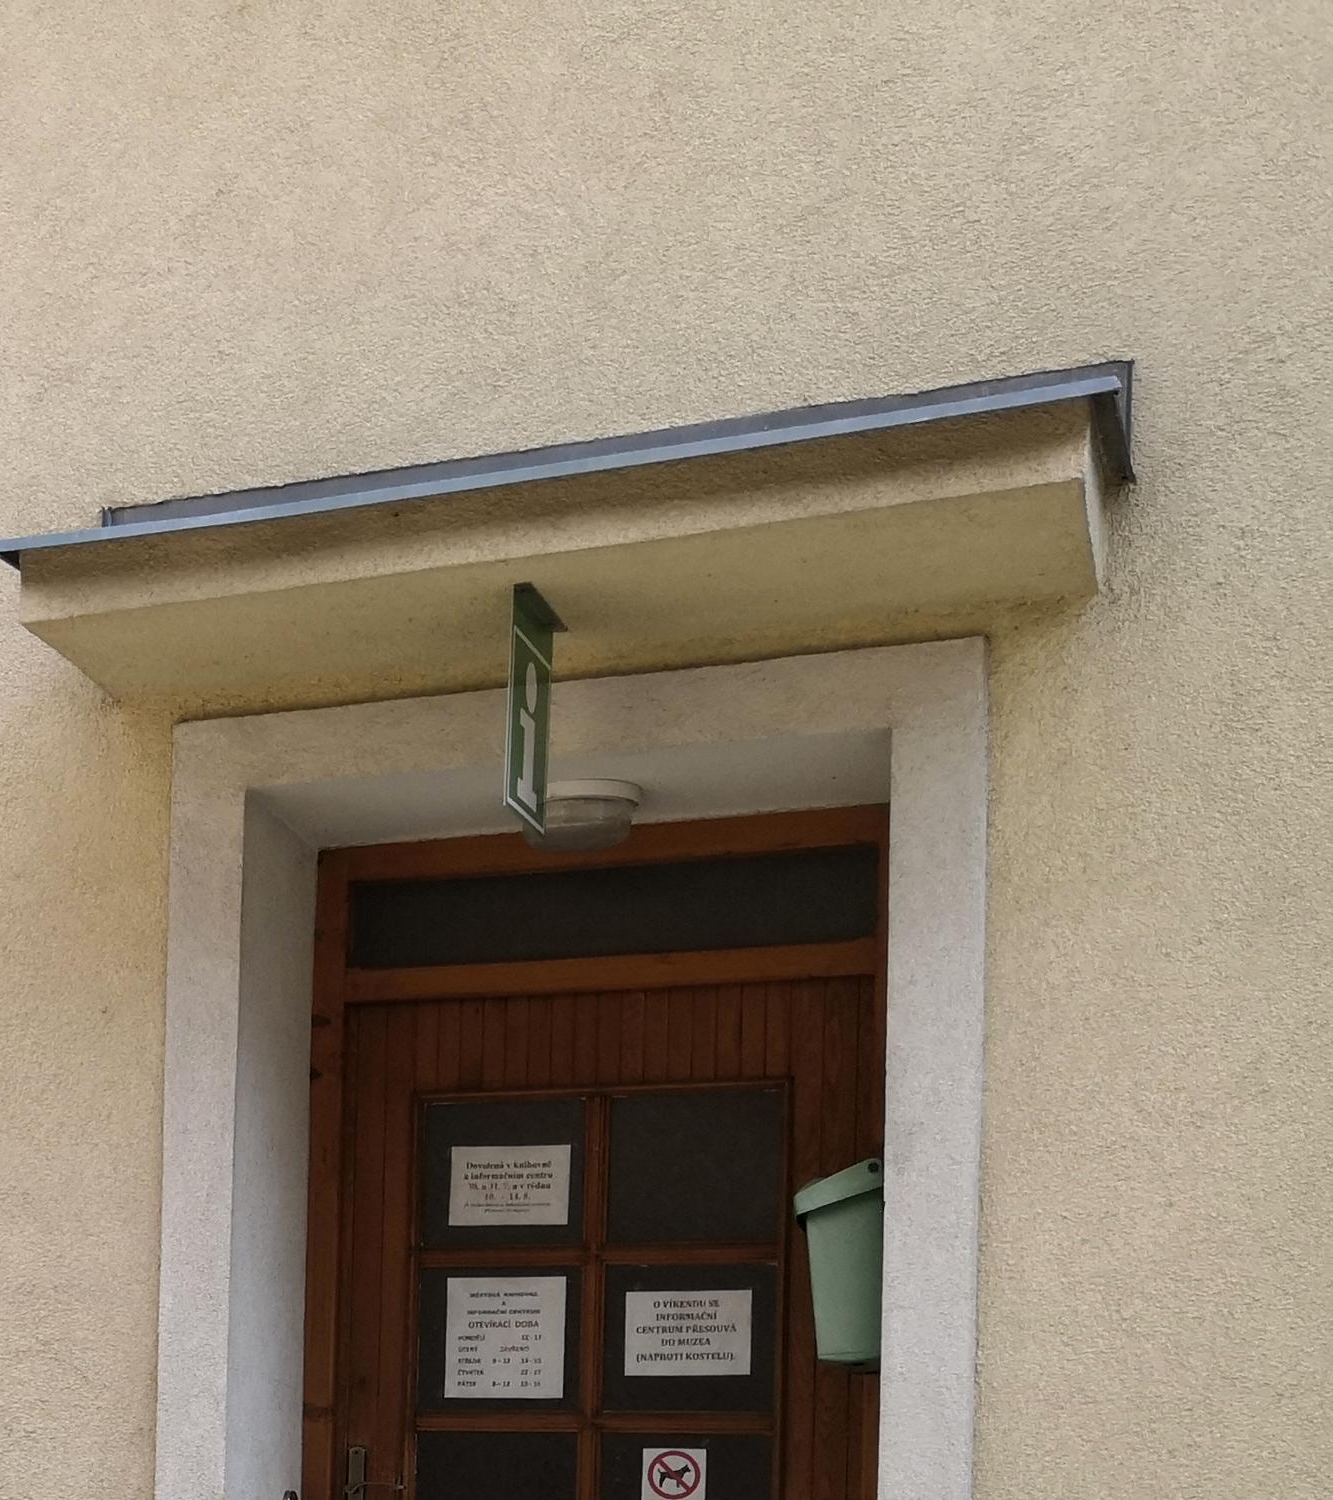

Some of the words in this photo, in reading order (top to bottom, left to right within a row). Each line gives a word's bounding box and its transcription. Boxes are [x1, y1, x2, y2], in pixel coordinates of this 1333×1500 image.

[653, 1301, 660, 1309] O
[663, 1299, 706, 1309] VÍKENDU
[656, 1311, 717, 1321] INFORMAČNÍ
[468, 1319, 511, 1329] OTEVÍRACÍ
[515, 1320, 539, 1328] DOBA
[636, 1326, 683, 1335] CENTRUM
[685, 1324, 737, 1334] PŘESOUVÁ
[661, 1338, 675, 1347] DO
[677, 1338, 711, 1346] MUZEA
